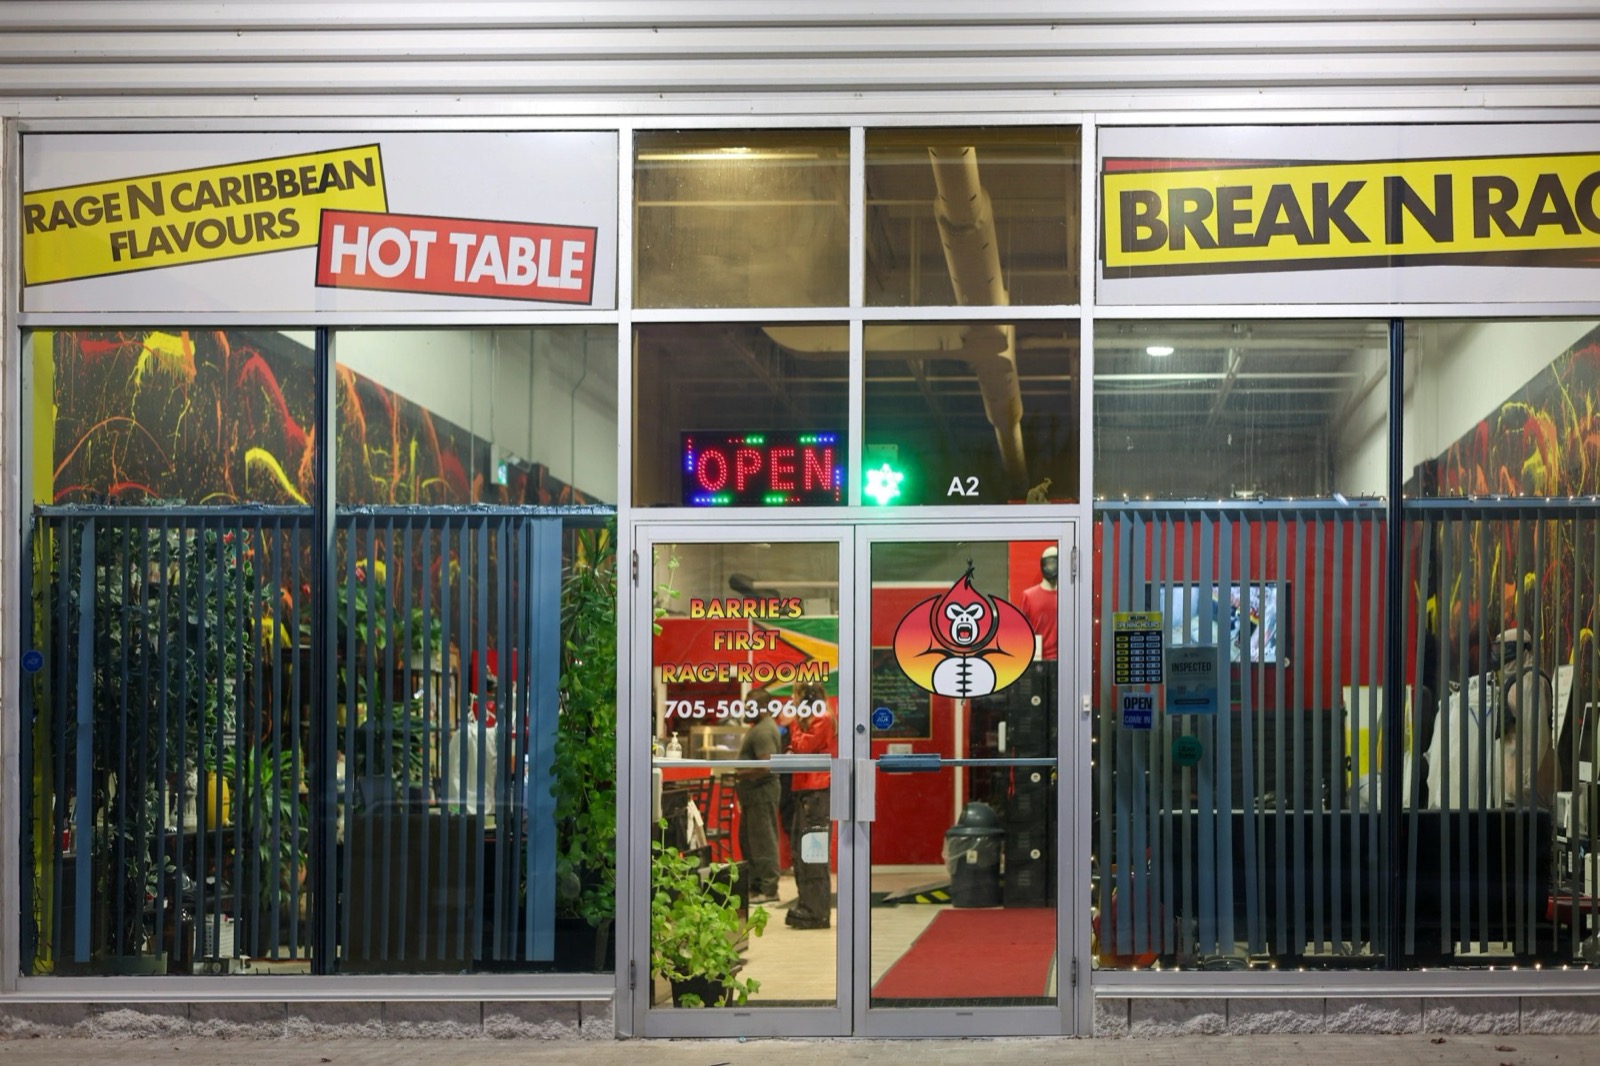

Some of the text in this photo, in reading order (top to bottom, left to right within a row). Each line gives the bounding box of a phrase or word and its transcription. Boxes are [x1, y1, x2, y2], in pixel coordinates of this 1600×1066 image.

[24, 156, 376, 234] RAGE N CARIBBEAN
[1119, 180, 1371, 253] BREAK
[1384, 174, 1454, 245] N
[111, 207, 300, 262] FLAVOURS
[330, 224, 586, 290] HOT TABLE
[697, 448, 832, 492] OPEN
[947, 476, 980, 497] A2
[690, 597, 802, 619] BARRIE'S
[713, 629, 780, 651] FIRST
[661, 660, 830, 684] RAGE ROOM!
[1171, 662, 1212, 673] INSPECTED
[664, 700, 827, 719] 705-503-9660
[1123, 697, 1152, 710] OPEN
[1124, 715, 1142, 725] COME
